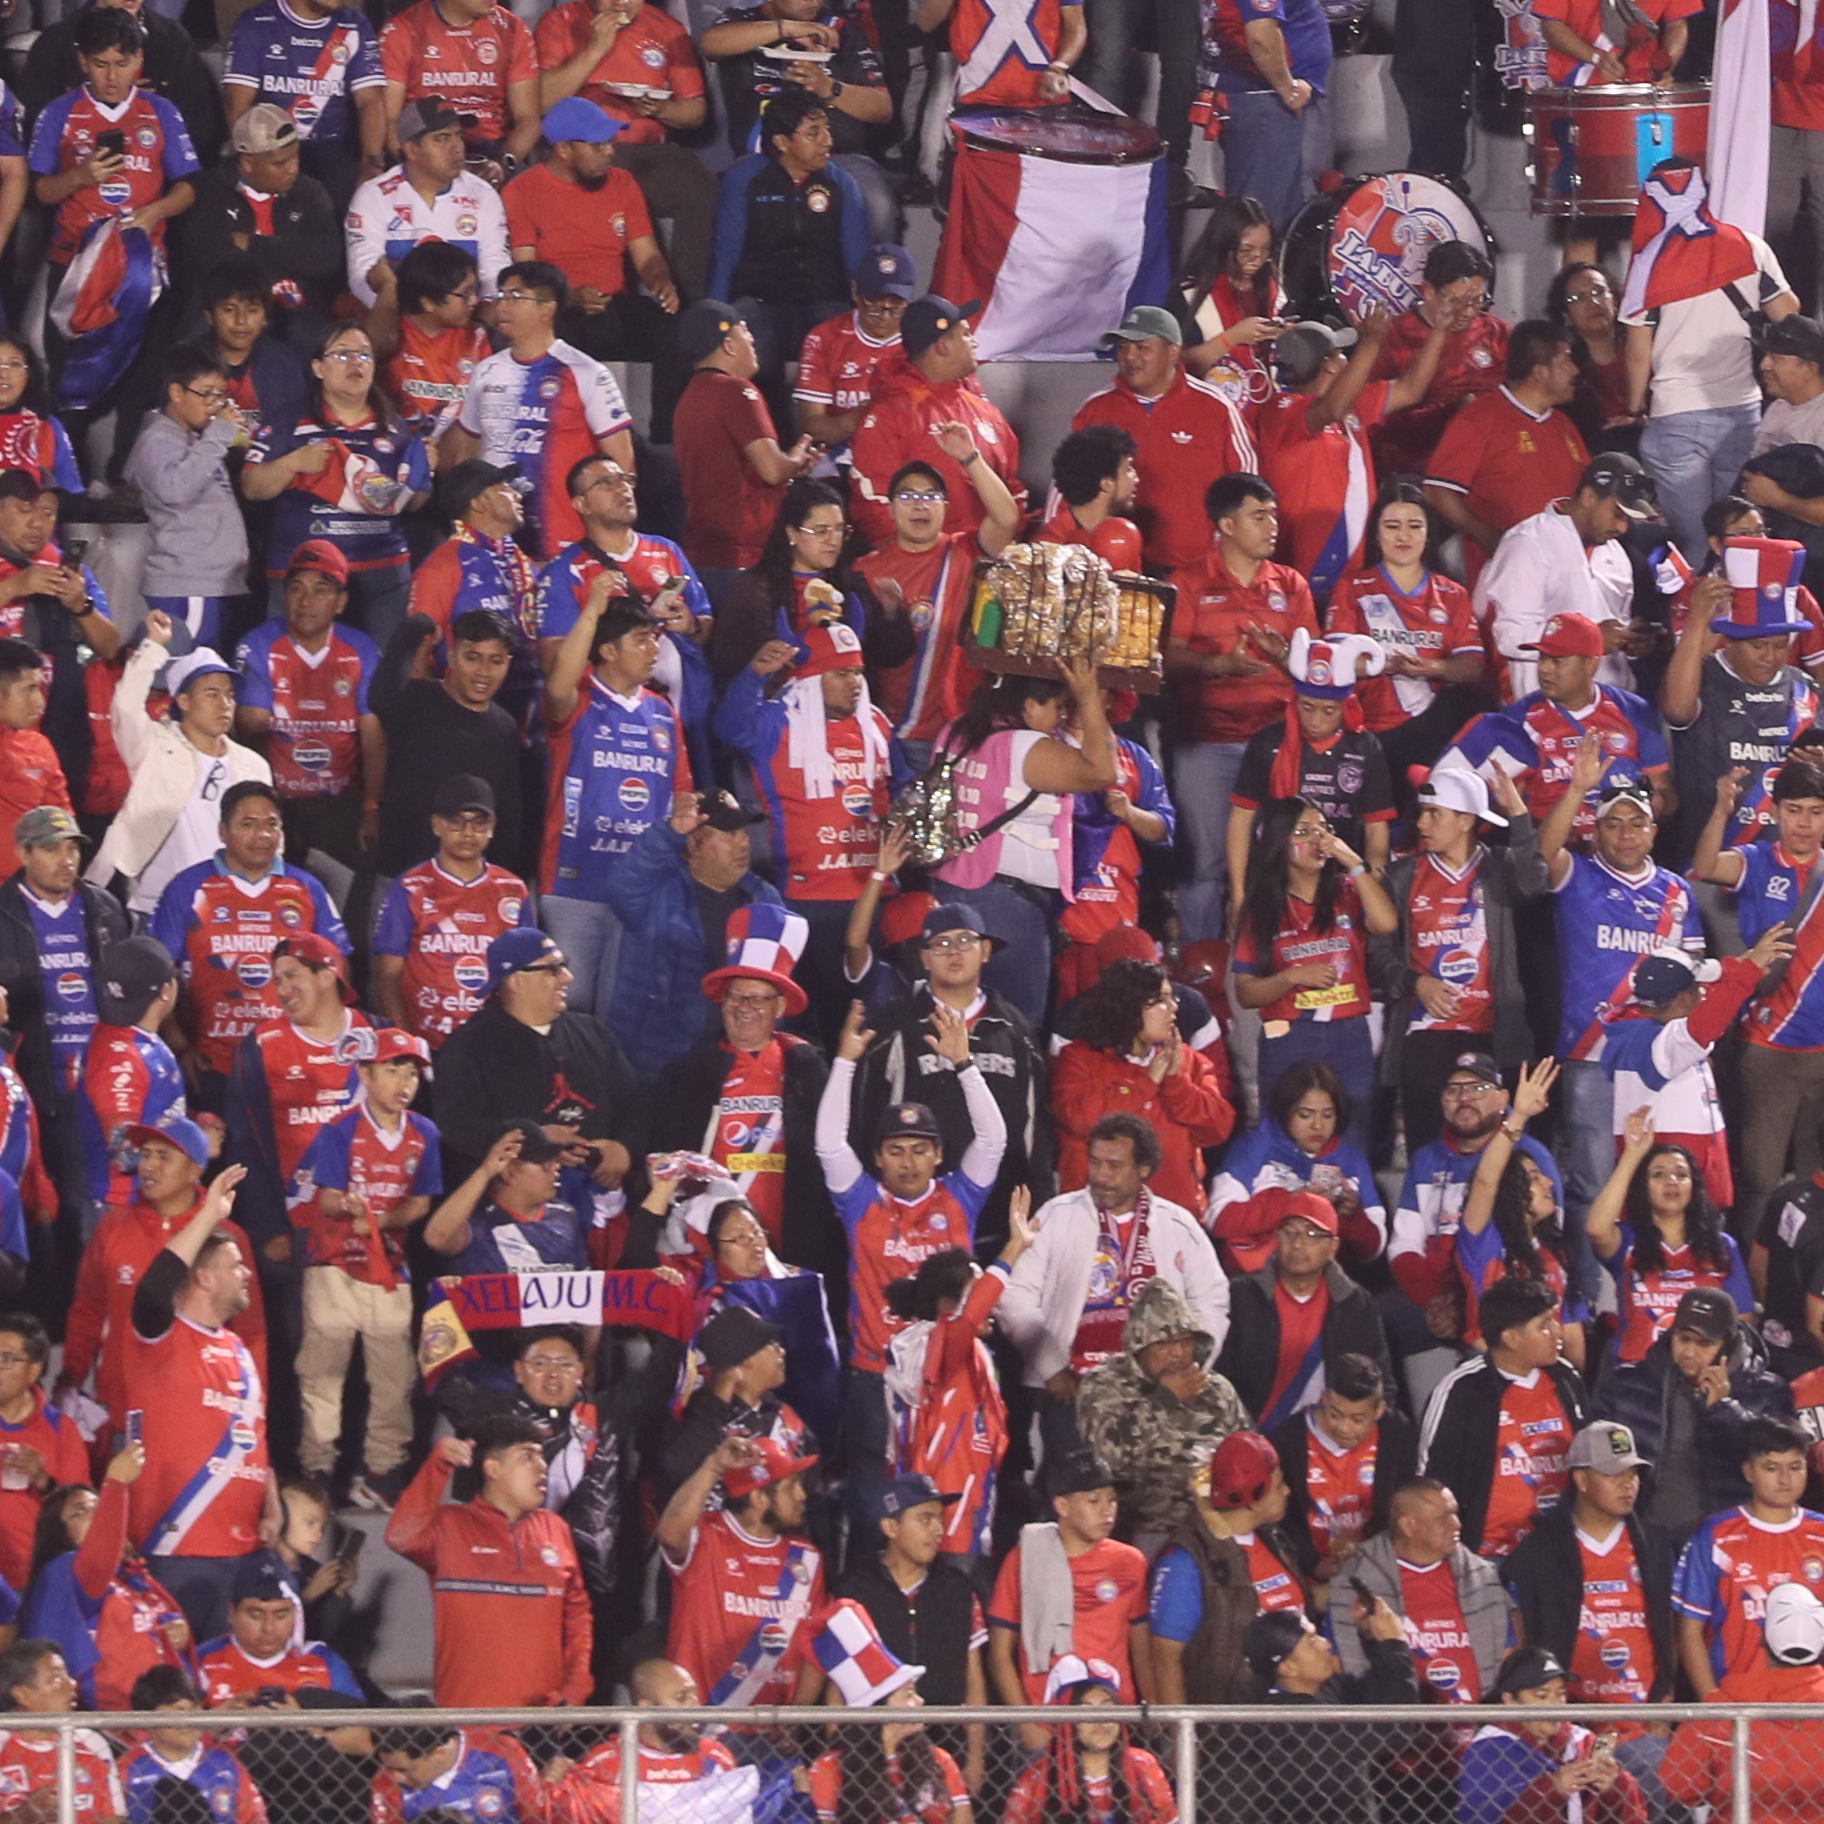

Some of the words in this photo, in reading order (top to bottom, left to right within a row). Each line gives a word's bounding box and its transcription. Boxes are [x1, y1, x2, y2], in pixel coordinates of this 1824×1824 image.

[262, 73, 345, 97] BANRURAL
[422, 70, 498, 89] BANRURAL
[1371, 631, 1445, 650] BANRURAL
[594, 750, 668, 777] BANRURAL
[1767, 876, 1789, 895] 82
[1281, 941, 1350, 963] BANRURAL
[1441, 962, 1478, 976] PEPSI
[919, 1053, 1016, 1078] RAERS
[458, 1276, 592, 1313] XELAJU
